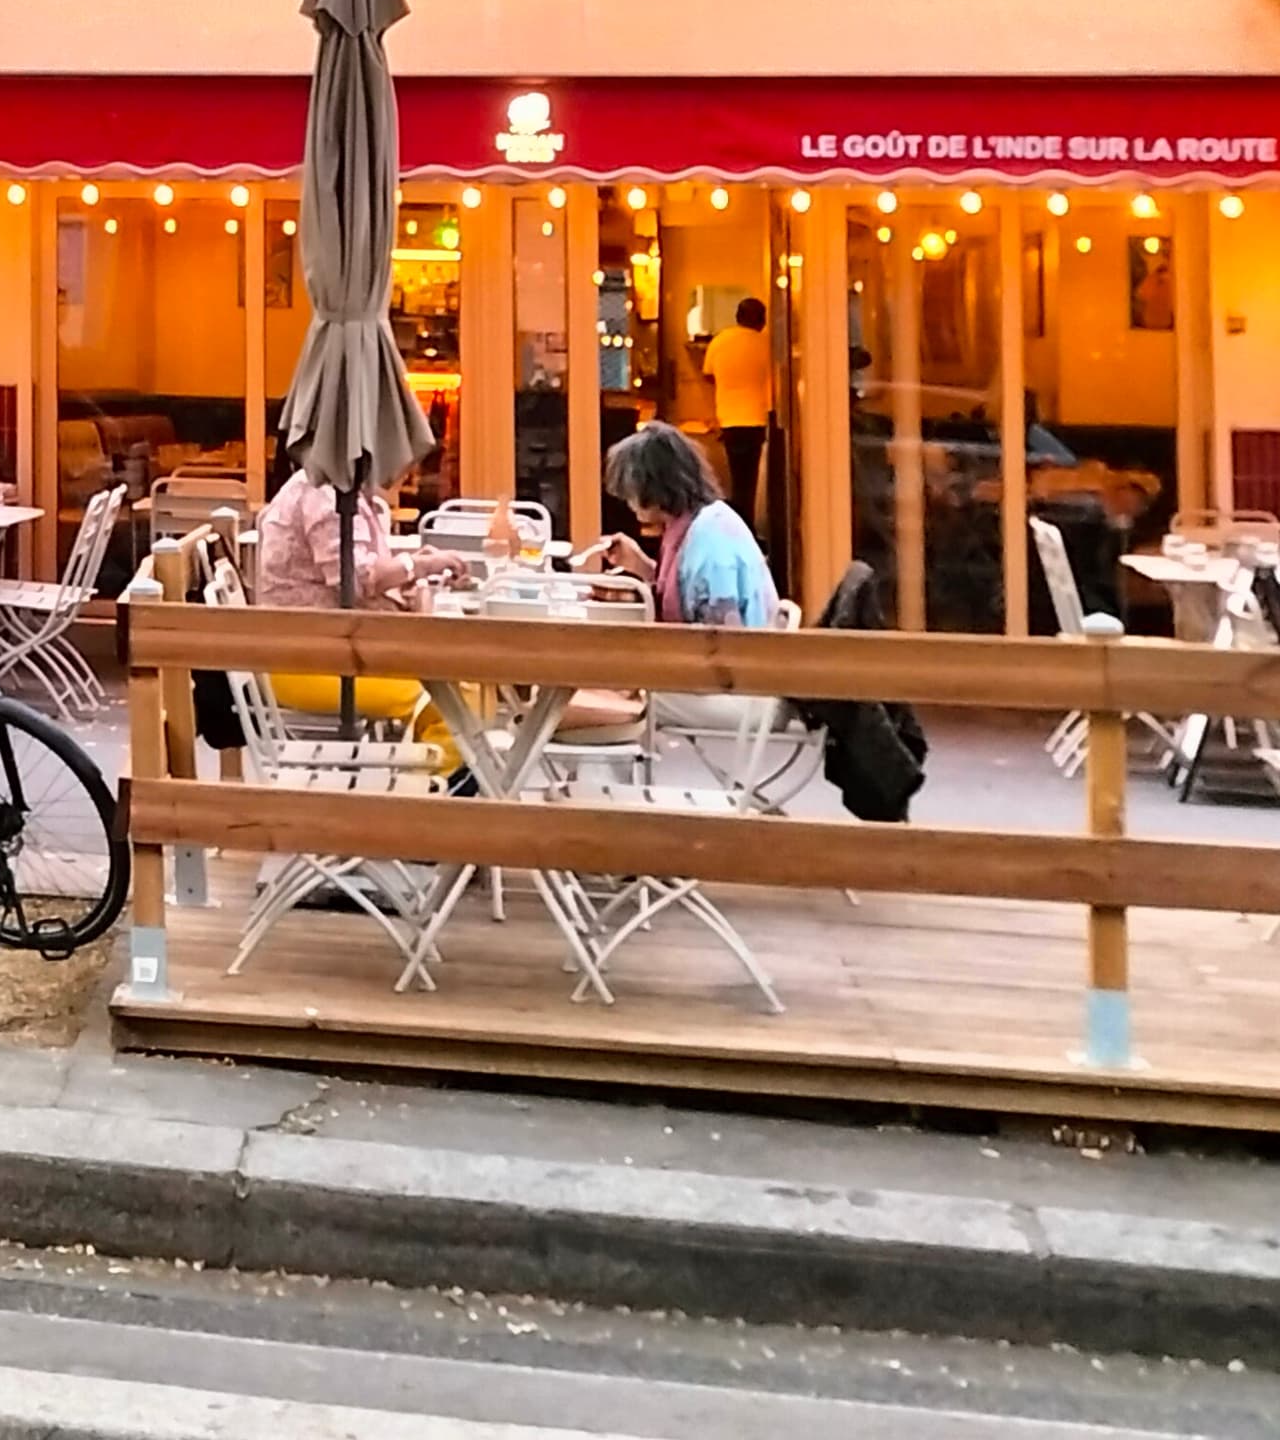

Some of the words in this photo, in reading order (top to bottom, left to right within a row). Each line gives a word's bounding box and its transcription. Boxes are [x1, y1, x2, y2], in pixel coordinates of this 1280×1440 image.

[801, 134, 838, 158] LE
[842, 129, 923, 158] GOÛT
[927, 134, 968, 158] DE
[972, 135, 1063, 160] L'INDE
[1067, 135, 1129, 161] SUR
[1133, 136, 1174, 161] LA
[1176, 137, 1278, 162] ROUTE
